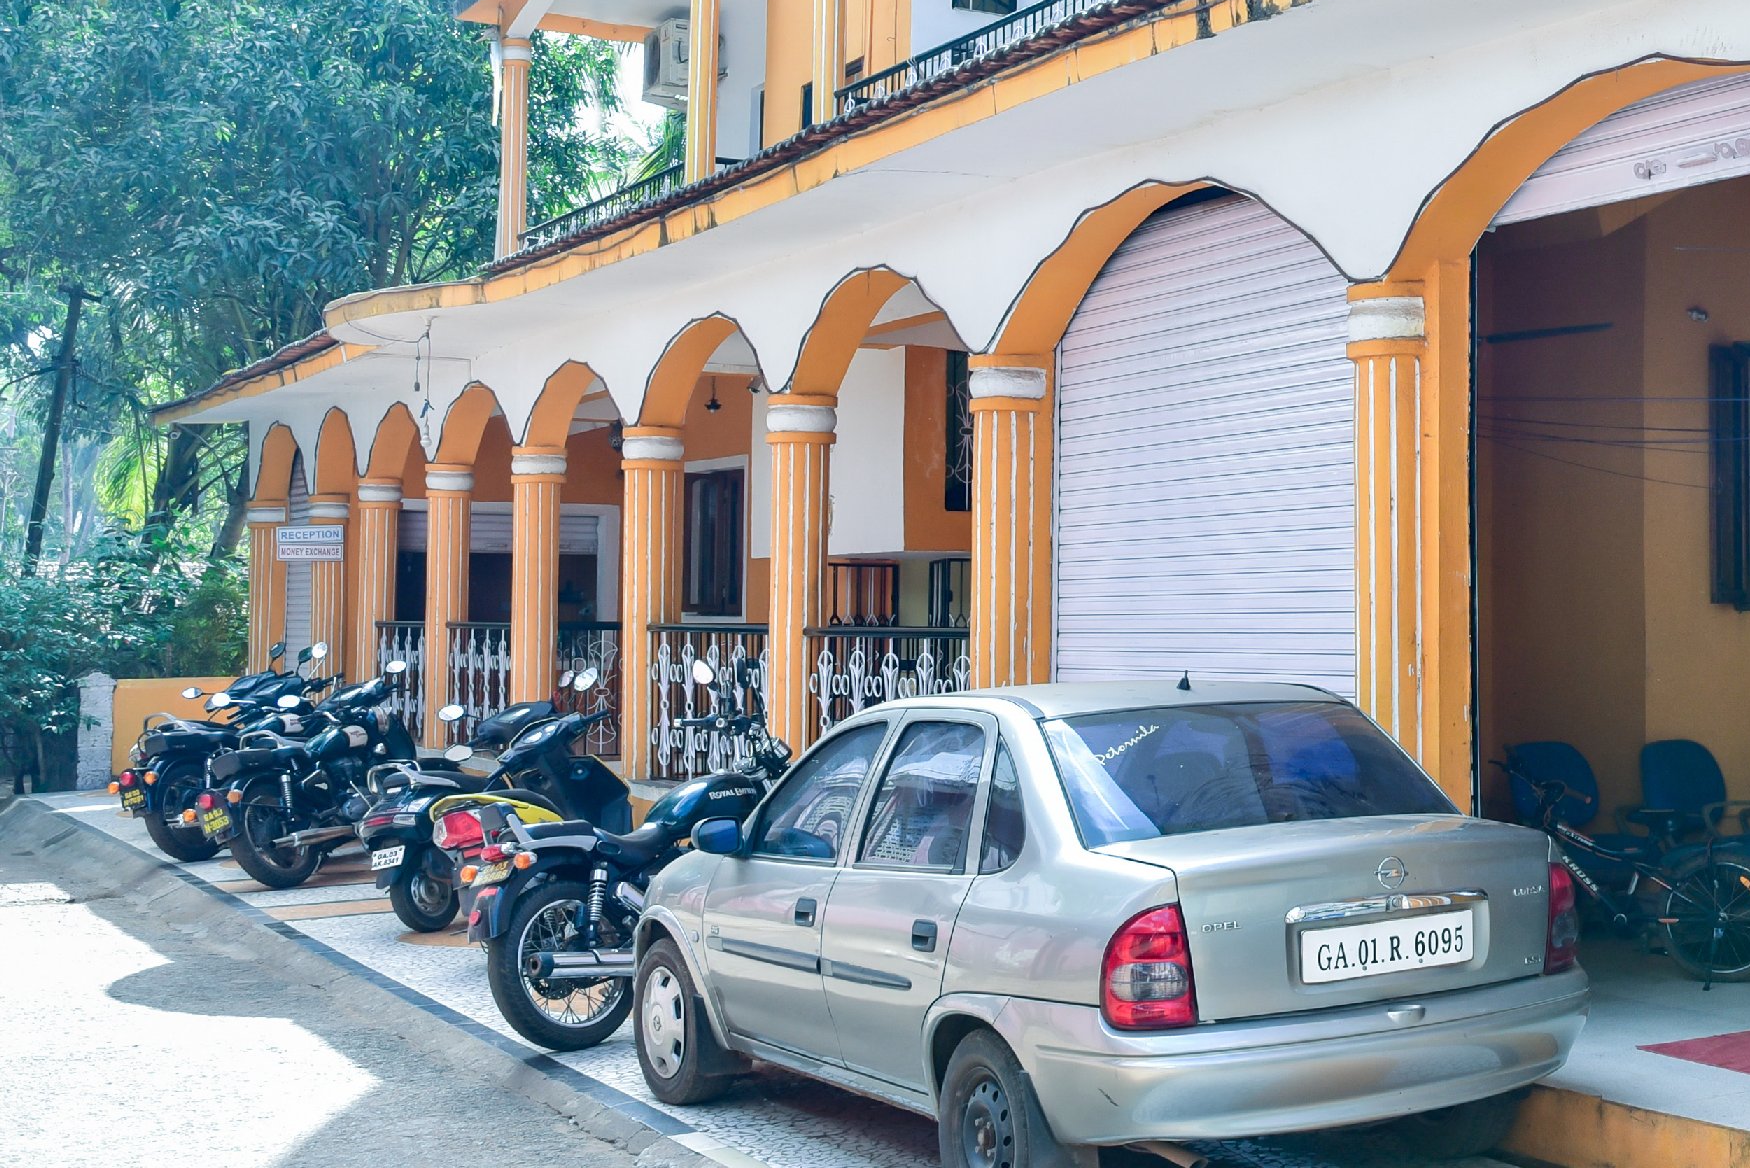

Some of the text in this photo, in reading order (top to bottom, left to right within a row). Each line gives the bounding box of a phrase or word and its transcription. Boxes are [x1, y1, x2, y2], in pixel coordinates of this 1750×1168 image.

[281, 530, 340, 540] RECEPTION
[281, 547, 340, 556] MONEY EXCHANGE
[708, 789, 735, 800] ROYAL
[1202, 920, 1242, 932] OPEL
